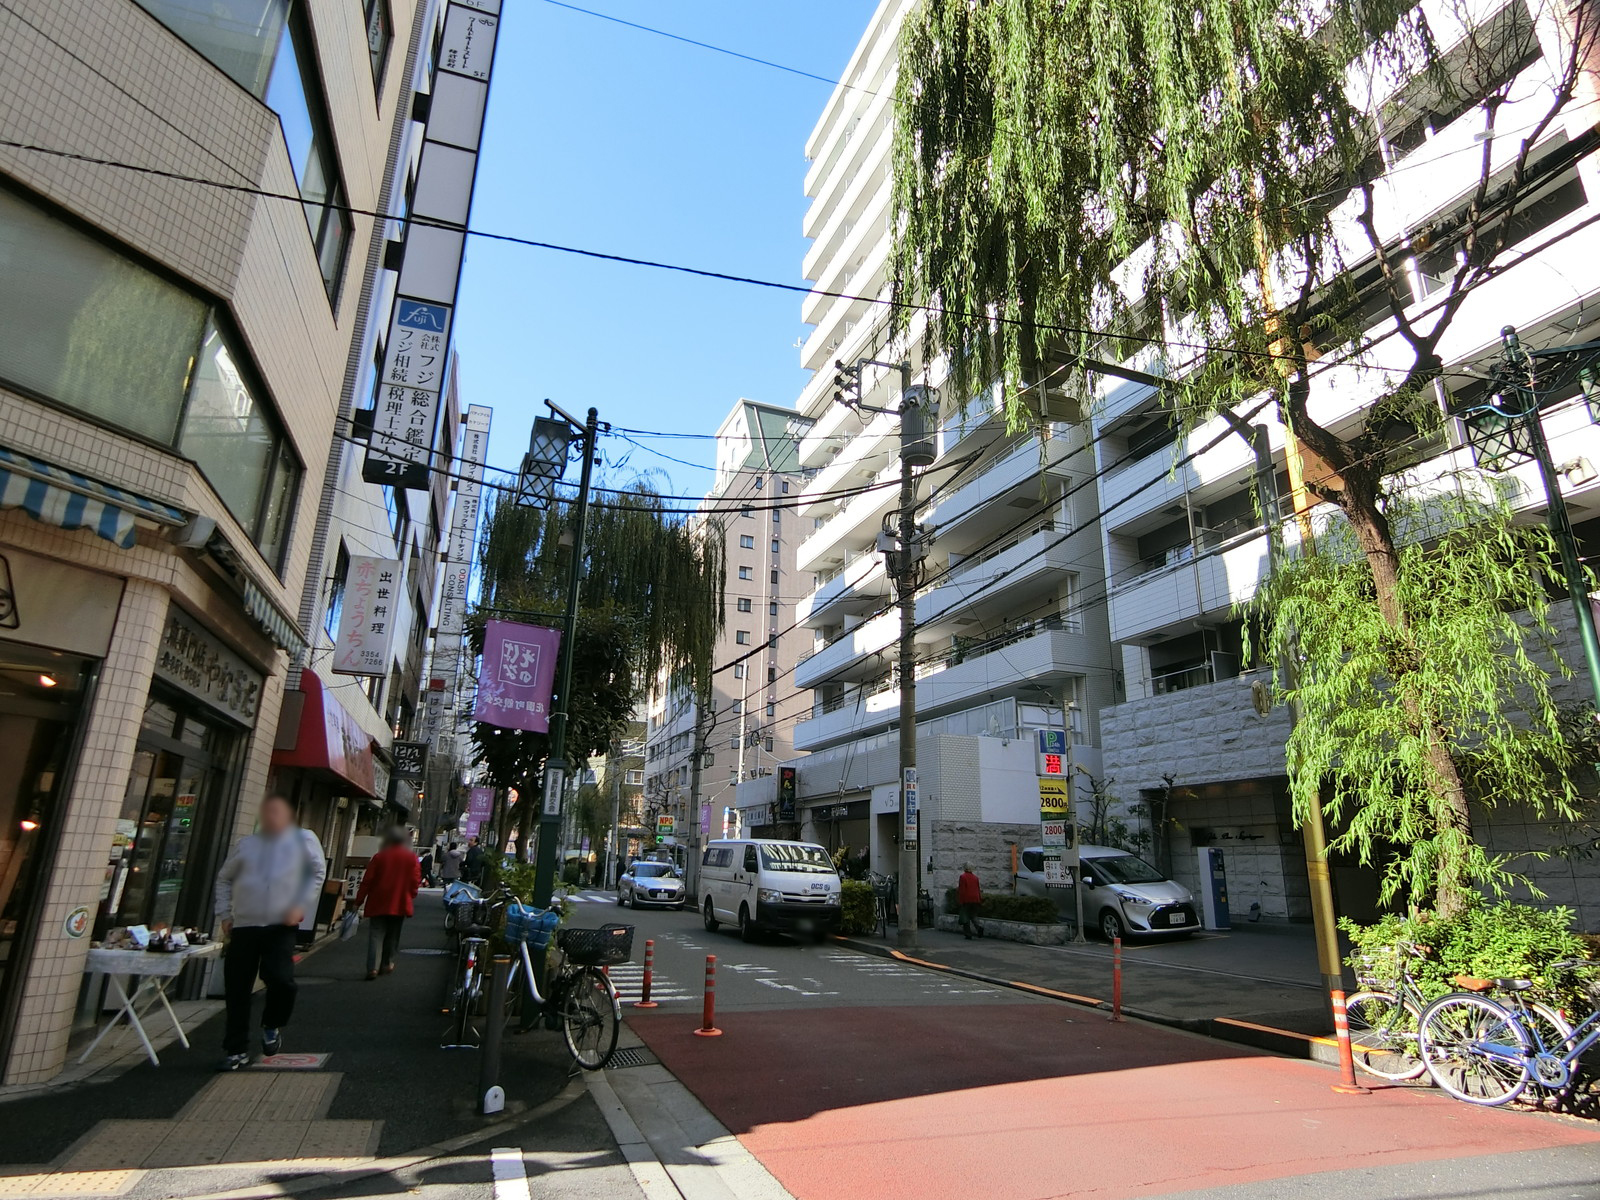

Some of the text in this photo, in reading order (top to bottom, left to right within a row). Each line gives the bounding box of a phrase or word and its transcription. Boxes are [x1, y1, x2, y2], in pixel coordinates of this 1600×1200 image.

[384, 462, 409, 475] 2F
[456, 568, 466, 595] ODASH
[371, 571, 392, 634] 出世料理
[443, 574, 456, 626] CONSULTING
[341, 561, 375, 666] 赤ちょうちん
[360, 650, 379, 658] 3354
[364, 658, 383, 666] 7266
[1046, 755, 1061, 774] 満
[660, 816, 673, 824] NPC
